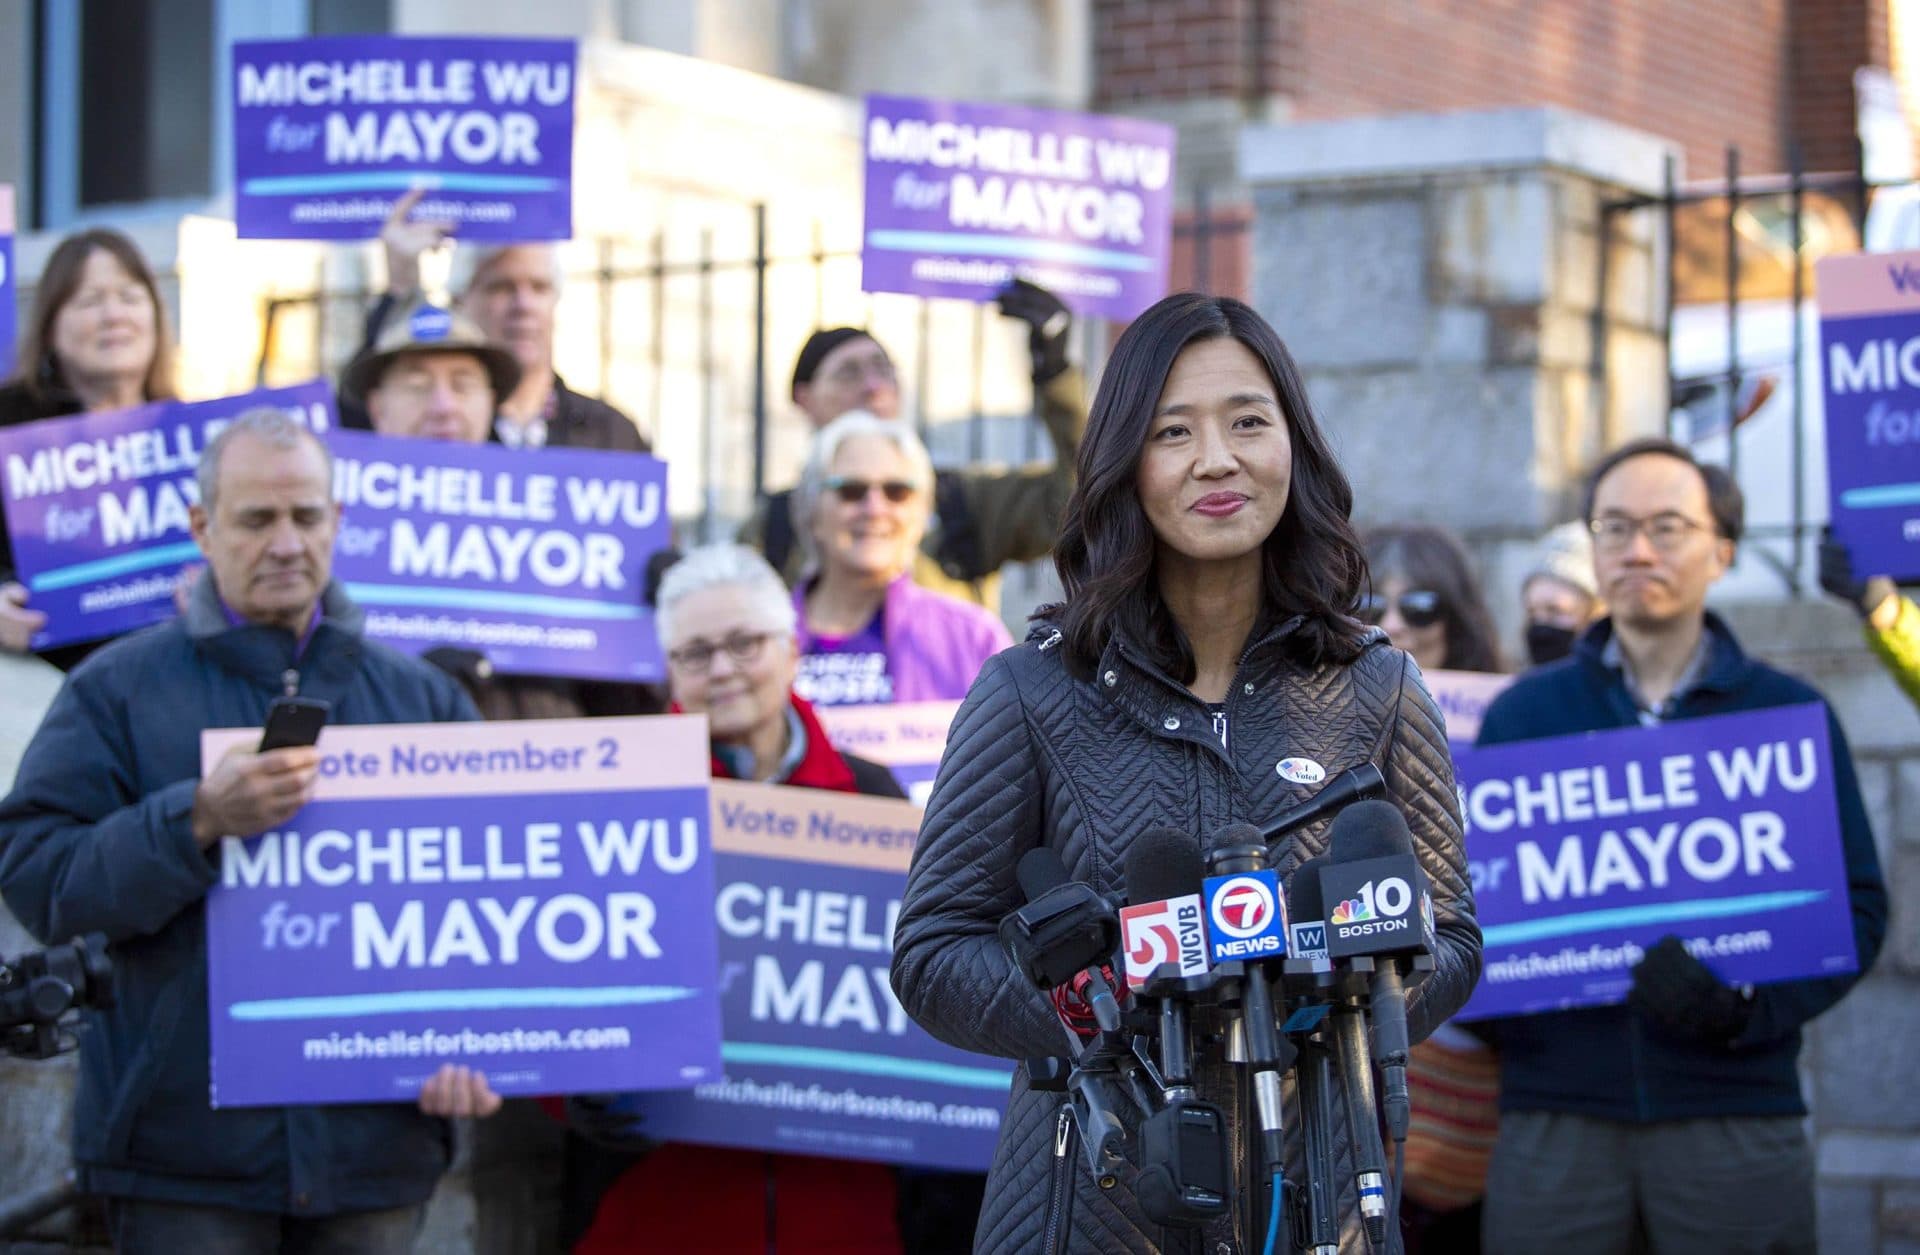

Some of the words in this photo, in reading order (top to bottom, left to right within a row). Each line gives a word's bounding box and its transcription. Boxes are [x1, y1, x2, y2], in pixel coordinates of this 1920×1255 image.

[239, 61, 475, 105] MICHELLE
[483, 62, 569, 105] WU
[265, 115, 319, 153] for
[325, 112, 540, 164] MAYOR
[869, 118, 1091, 181] MICHELLE
[1098, 142, 1169, 190] WU
[949, 175, 1143, 244] MAYOR
[44, 502, 94, 543] for
[565, 476, 660, 528] WU
[389, 518, 625, 590] MAYOR
[364, 611, 598, 649] ichelleforboston.com
[318, 748, 379, 778] ote
[391, 741, 584, 776] November
[597, 738, 619, 769] 2
[1296, 771, 1318, 781] Voted
[1707, 738, 1819, 802] WU
[719, 800, 798, 839] Vote
[220, 823, 563, 888] MICHELLE
[577, 817, 699, 876] WU
[1468, 855, 1509, 895] or
[1517, 810, 1794, 905] MAYOR
[1222, 890, 1264, 929] 7
[1356, 876, 1412, 919] 10
[261, 902, 340, 949] for
[352, 891, 662, 969] MAYOR
[1178, 904, 1204, 970] WCVB
[1215, 935, 1280, 958] NEWS
[1299, 930, 1321, 946] W
[1338, 918, 1408, 938] BOSTON
[303, 1025, 630, 1061] michelleforboston.com
